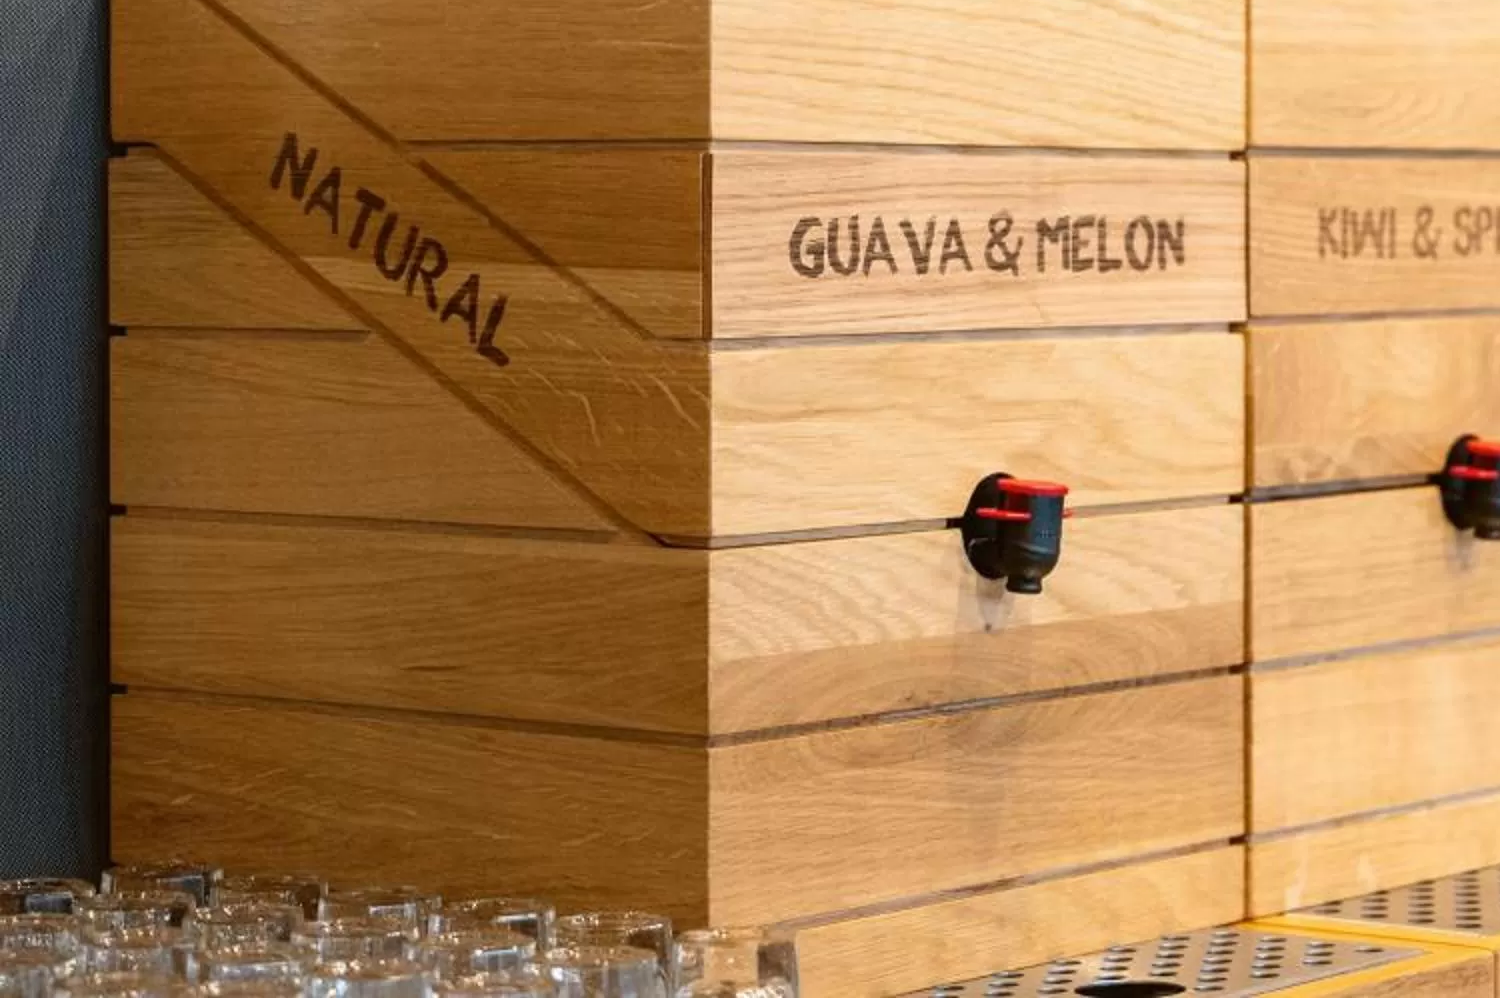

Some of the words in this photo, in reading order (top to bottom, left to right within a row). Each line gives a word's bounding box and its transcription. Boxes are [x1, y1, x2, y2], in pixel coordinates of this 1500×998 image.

[270, 131, 510, 366] NATURAL
[788, 213, 973, 278] GUAVA
[984, 209, 1023, 276] &
[1036, 214, 1185, 273] MELON
[1318, 206, 1397, 259] KIWI
[1412, 205, 1443, 260] &
